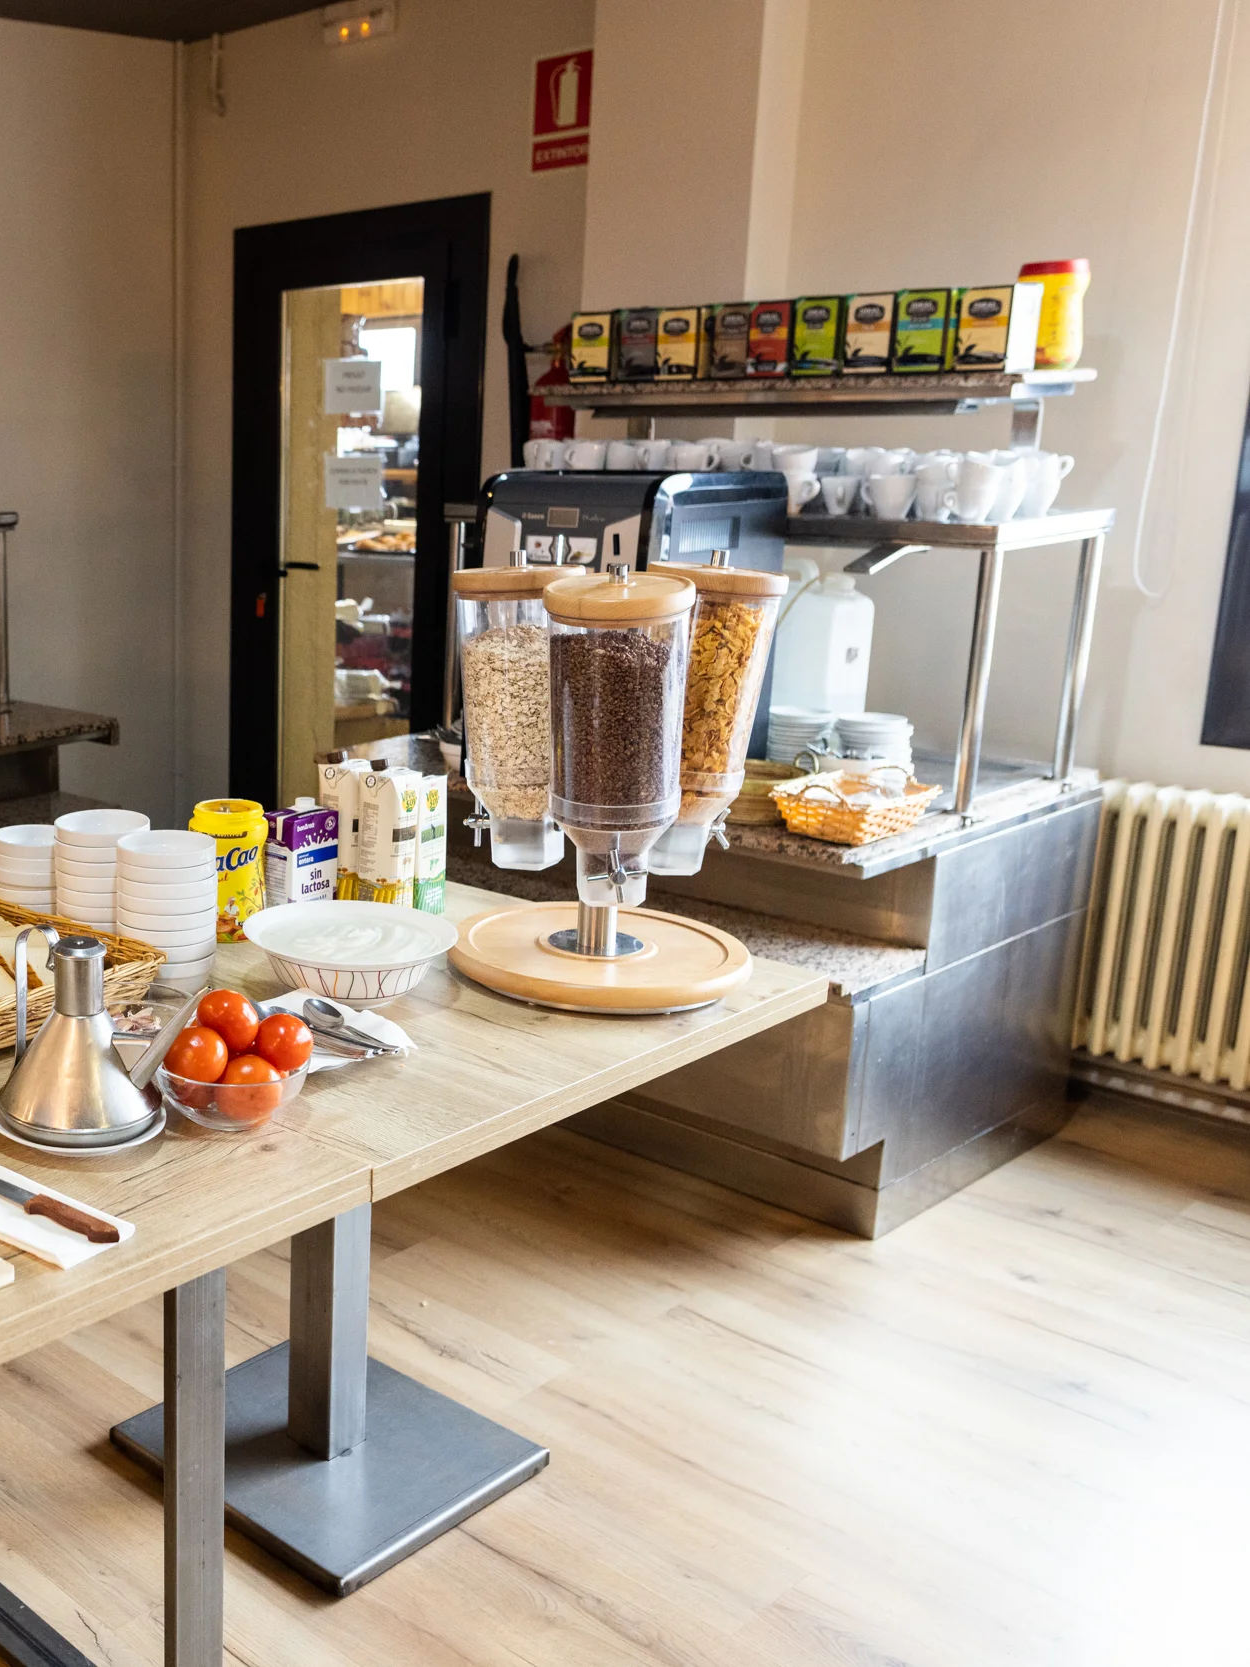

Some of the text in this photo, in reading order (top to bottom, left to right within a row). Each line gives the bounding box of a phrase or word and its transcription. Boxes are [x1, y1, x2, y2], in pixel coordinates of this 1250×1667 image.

[215, 846, 259, 871] aCao
[310, 867, 322, 880] sin
[301, 879, 330, 894] lactosa
